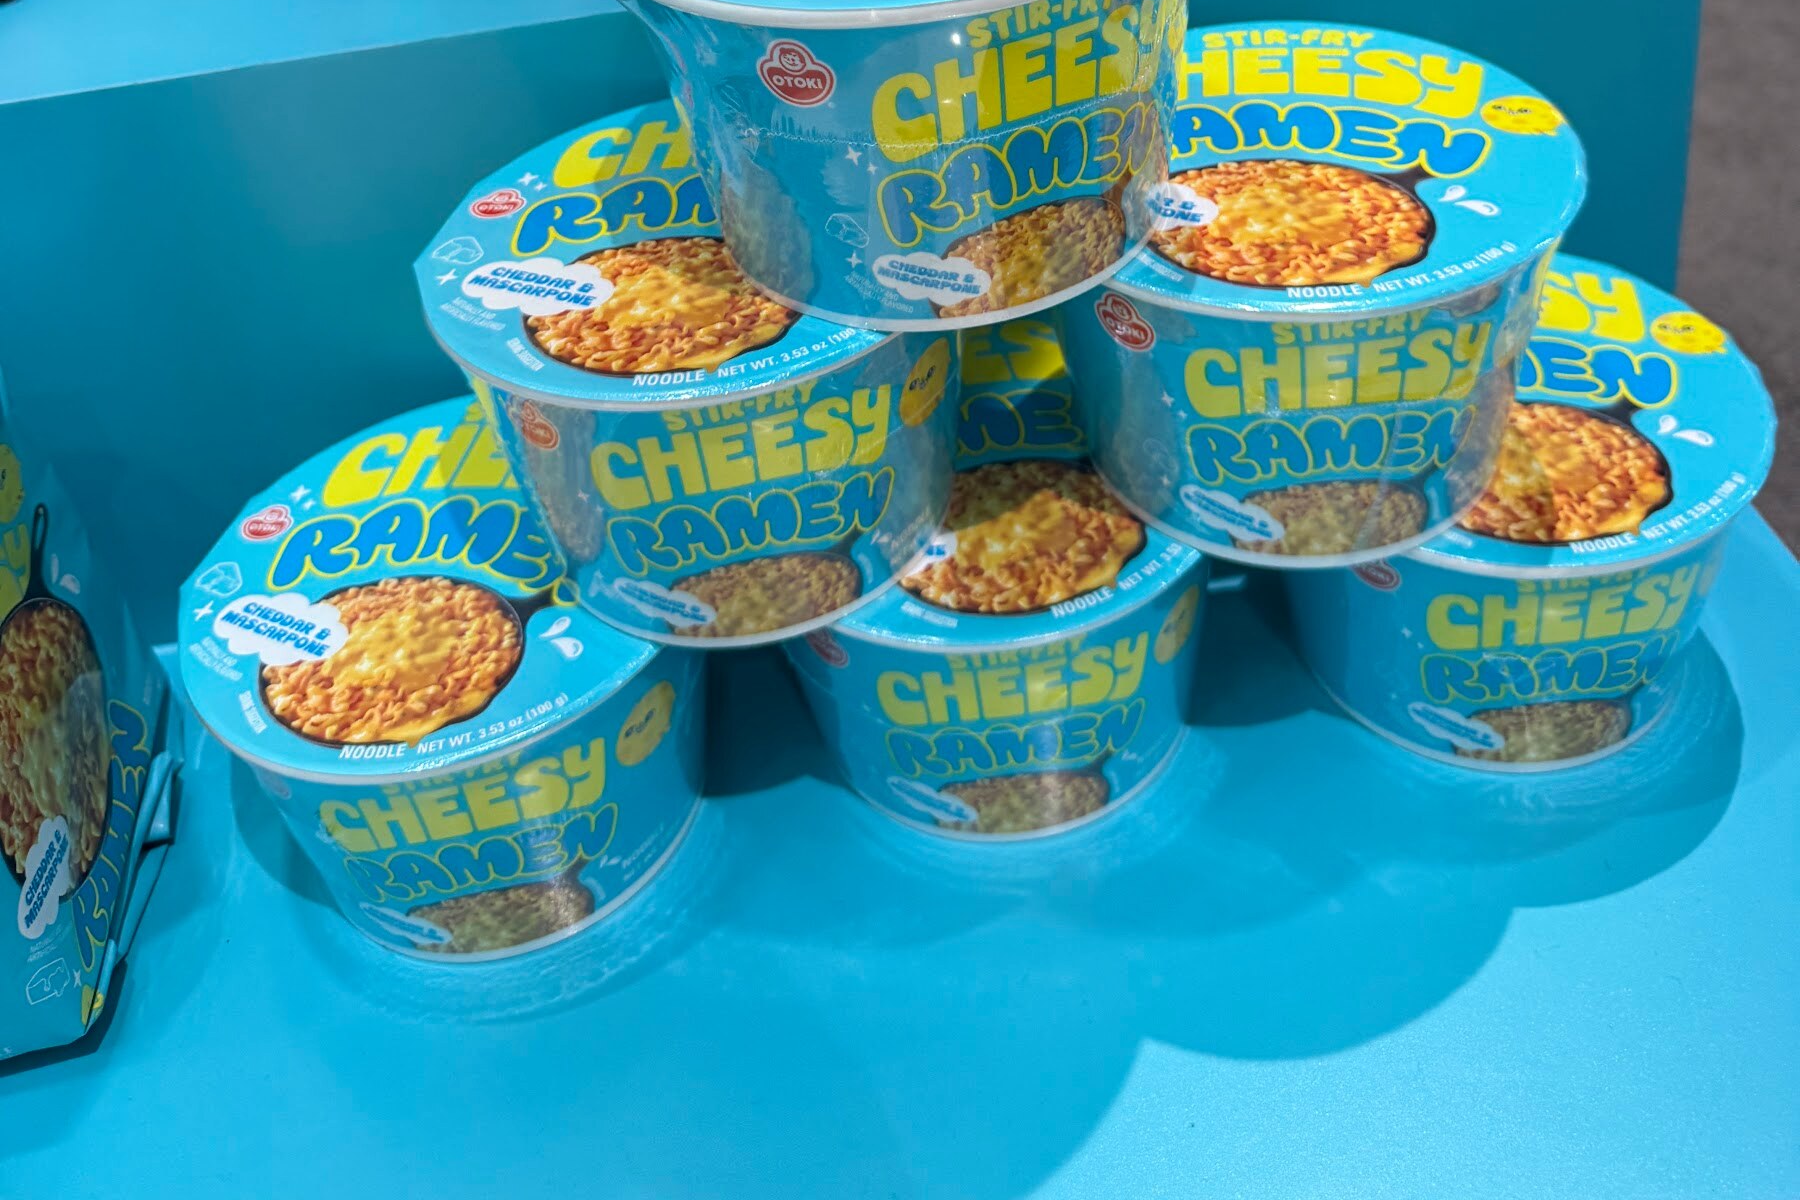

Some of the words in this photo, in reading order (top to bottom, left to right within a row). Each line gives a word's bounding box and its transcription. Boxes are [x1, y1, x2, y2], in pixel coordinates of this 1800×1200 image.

[1202, 29, 1373, 50] STIR-FRY
[772, 73, 824, 92] OTOKI
[871, 0, 1159, 163] CHEESY
[1177, 47, 1484, 119] HEESY
[1171, 100, 1493, 179] AMEN
[877, 99, 1157, 248] RAMEN
[468, 274, 598, 307] MASCARPONE
[491, 266, 577, 290] CHEDDAR
[579, 282, 597, 293] &
[877, 266, 982, 295] MASCARPONE
[888, 259, 960, 282] CHEDDAR
[963, 274, 976, 284] &
[1287, 284, 1363, 299] NOODLE
[1373, 279, 1403, 293] NET
[1407, 273, 1435, 287] WT.
[1433, 263, 1464, 280] 3.53
[1462, 259, 1480, 271] oz
[1273, 308, 1430, 345] STIR-FRY
[632, 370, 706, 386] NOODLE
[717, 364, 747, 378] NET
[750, 356, 780, 371] WT.
[780, 345, 810, 362] 3.53
[812, 341, 828, 352] oz
[1184, 320, 1492, 418] CHEESY
[661, 379, 817, 431] STIR-FRY
[591, 384, 891, 510] CHEESY
[1187, 404, 1477, 486] RAMEN
[607, 466, 895, 577] RAMEN
[1568, 531, 1639, 554] NOODLE
[1641, 525, 1669, 540] NET
[243, 602, 316, 635] CHEDDAR
[315, 628, 331, 640] &
[1050, 585, 1115, 619] NOODLE
[1118, 571, 1143, 591] NET
[1426, 565, 1699, 651] CHEESY
[221, 610, 330, 657] MASCARPONE
[876, 631, 1150, 727] CHEESY
[1420, 630, 1680, 705] RAMEN
[339, 743, 408, 760] NOODLE
[416, 739, 447, 754] NET
[449, 731, 475, 748] WT.
[478, 721, 507, 739] 3.53
[508, 716, 525, 728] oz
[525, 701, 553, 721] (100
[885, 698, 1146, 778] RAMEN
[320, 738, 606, 853] CHEESY
[25, 841, 57, 906] CHEDDAR
[344, 802, 619, 903] RAMEN
